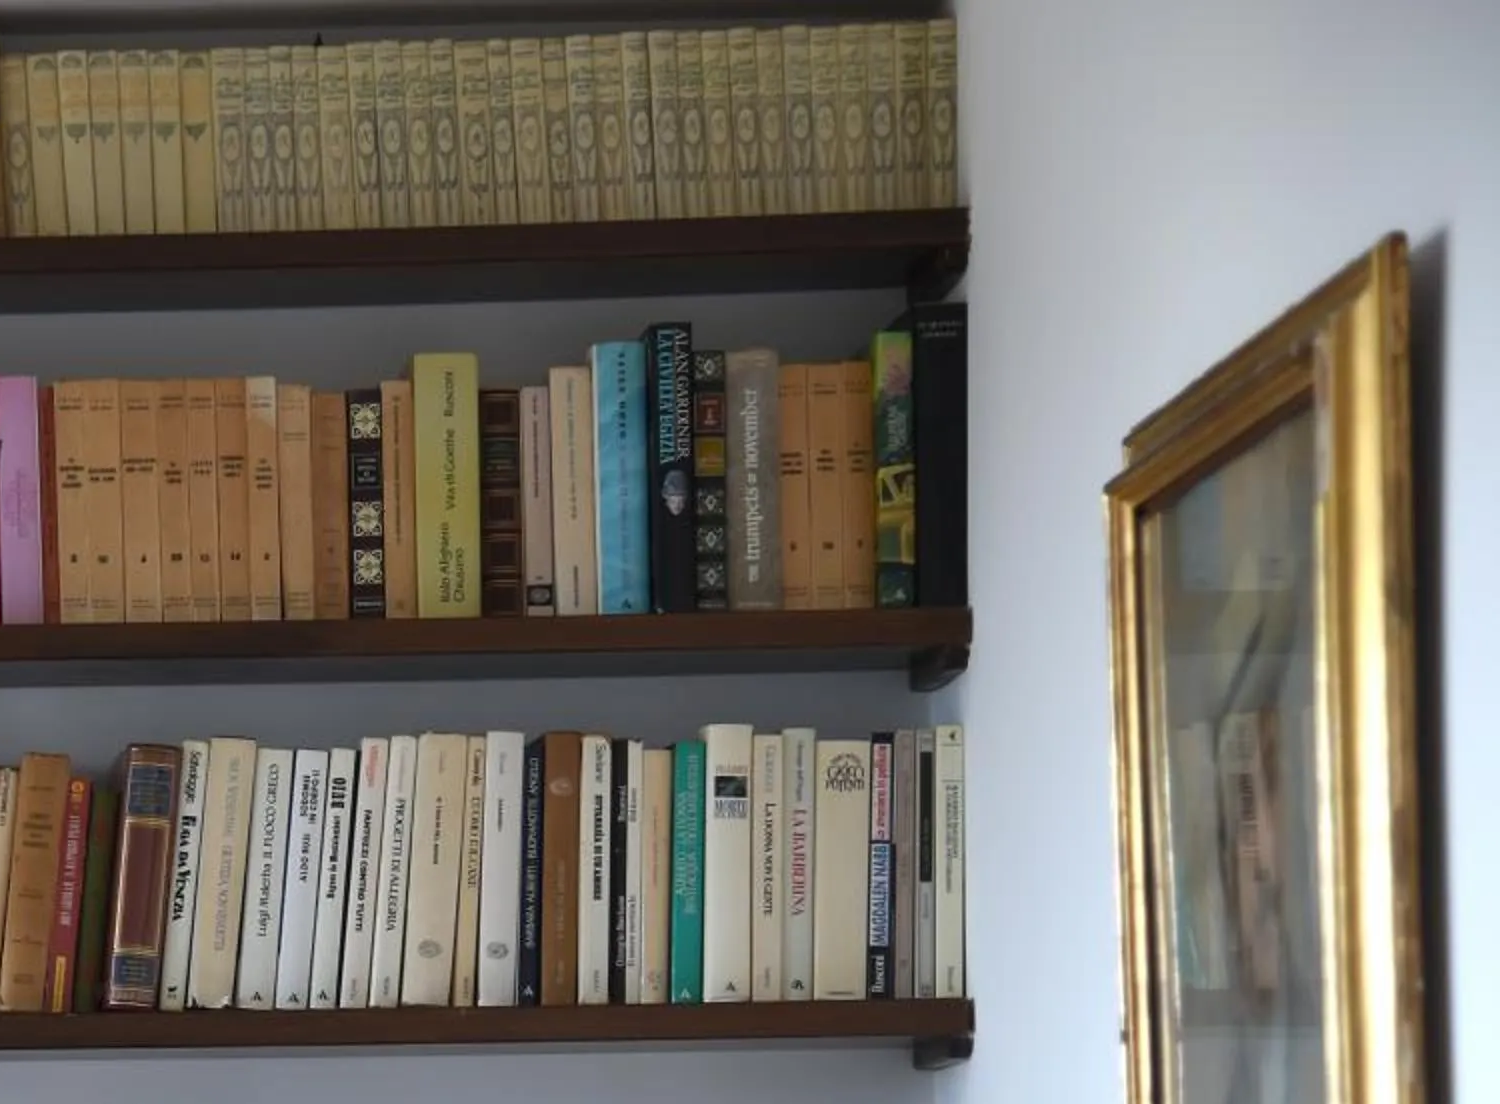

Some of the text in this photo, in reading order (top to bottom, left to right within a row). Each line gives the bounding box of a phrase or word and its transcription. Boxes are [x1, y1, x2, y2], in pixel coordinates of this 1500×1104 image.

[658, 330, 674, 348] LA
[443, 370, 454, 416] Rusconi
[675, 328, 691, 462] ALAN GARDINER
[443, 427, 455, 472] Goethe
[658, 415, 674, 466] EGIZIA
[740, 387, 764, 561] trumpets november
[267, 762, 280, 804] GRECO
[262, 806, 276, 848] FUOCO
[390, 797, 405, 856] PROGETTI
[763, 802, 777, 818] LA
[792, 808, 807, 828] LA
[763, 819, 773, 853] DONNA
[171, 869, 191, 921] VENEZIA
[259, 863, 272, 908] Malerba
[357, 860, 368, 900] CONTRO
[385, 872, 400, 931] ALLEGRIA
[762, 883, 772, 917] GENTE
[870, 845, 887, 943] MAGDALEN NABB
[256, 909, 270, 937] Luigi
[354, 903, 365, 931] TUTTI
